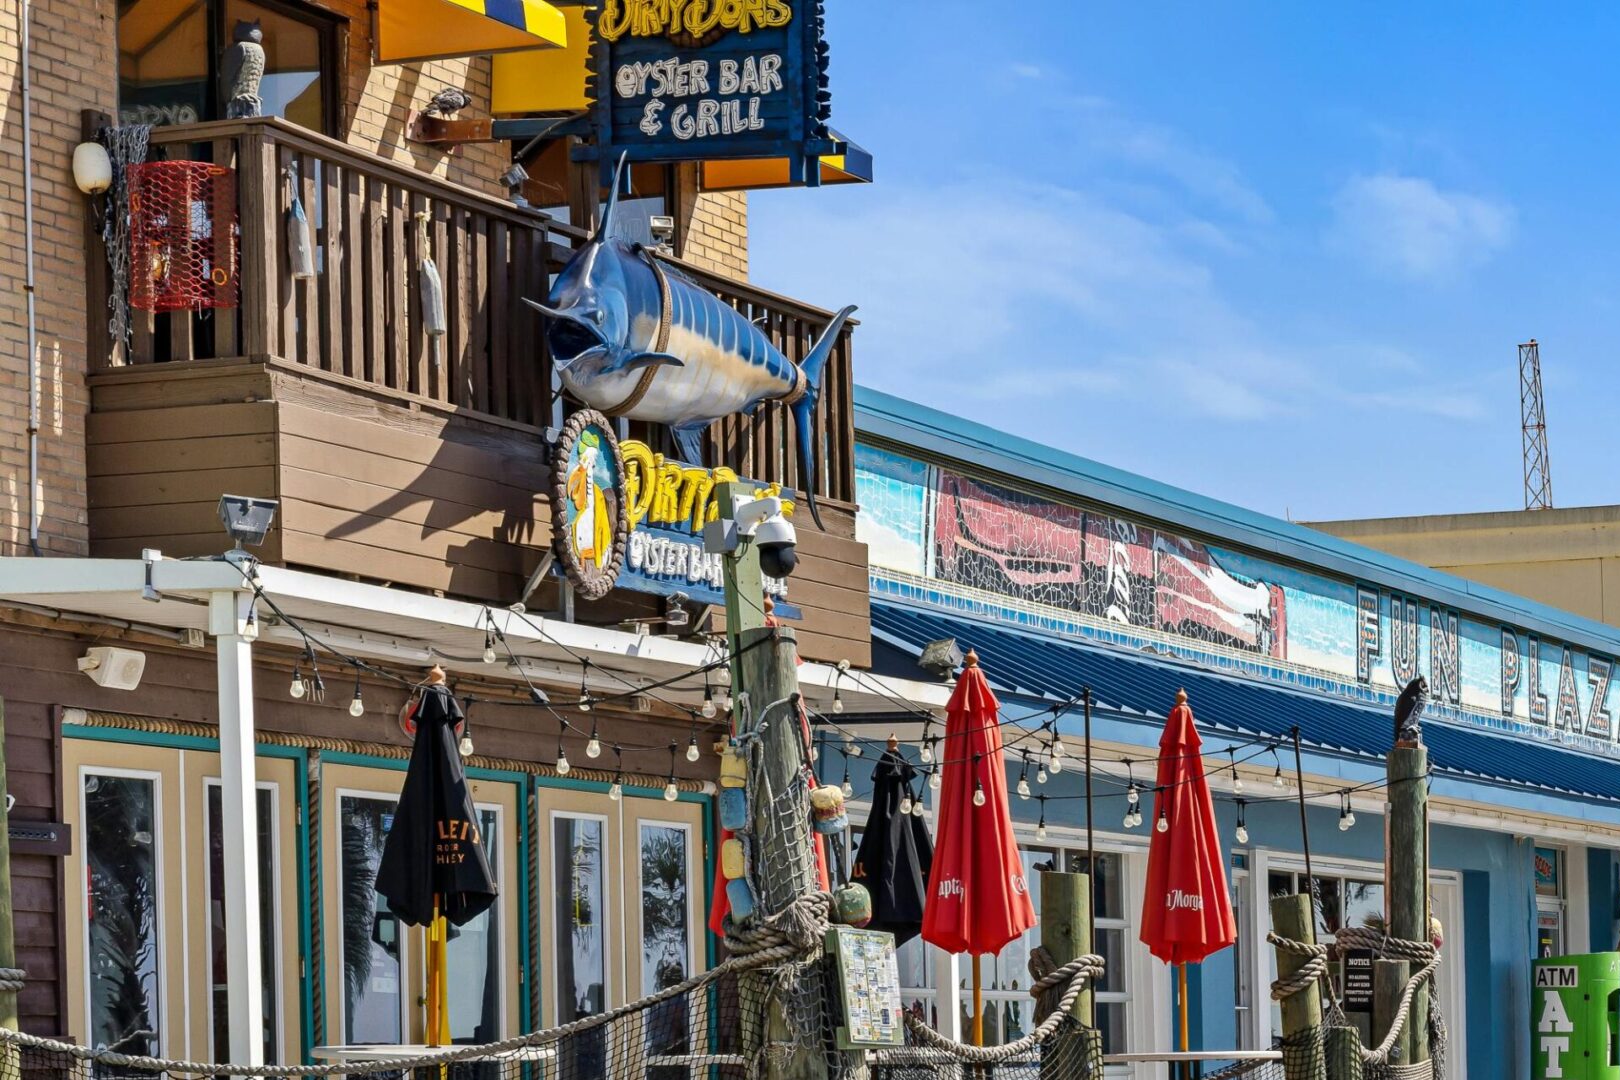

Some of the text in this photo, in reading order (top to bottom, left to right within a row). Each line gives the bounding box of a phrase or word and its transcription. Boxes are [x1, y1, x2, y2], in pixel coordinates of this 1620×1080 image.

[615, 54, 783, 98] OYSTER BAR
[639, 97, 765, 140] & GRILL
[628, 531, 687, 576] OYSTER
[1356, 582, 1460, 706] FUN
[1348, 958, 1371, 966] NOTICE
[1537, 967, 1576, 987] ATM
